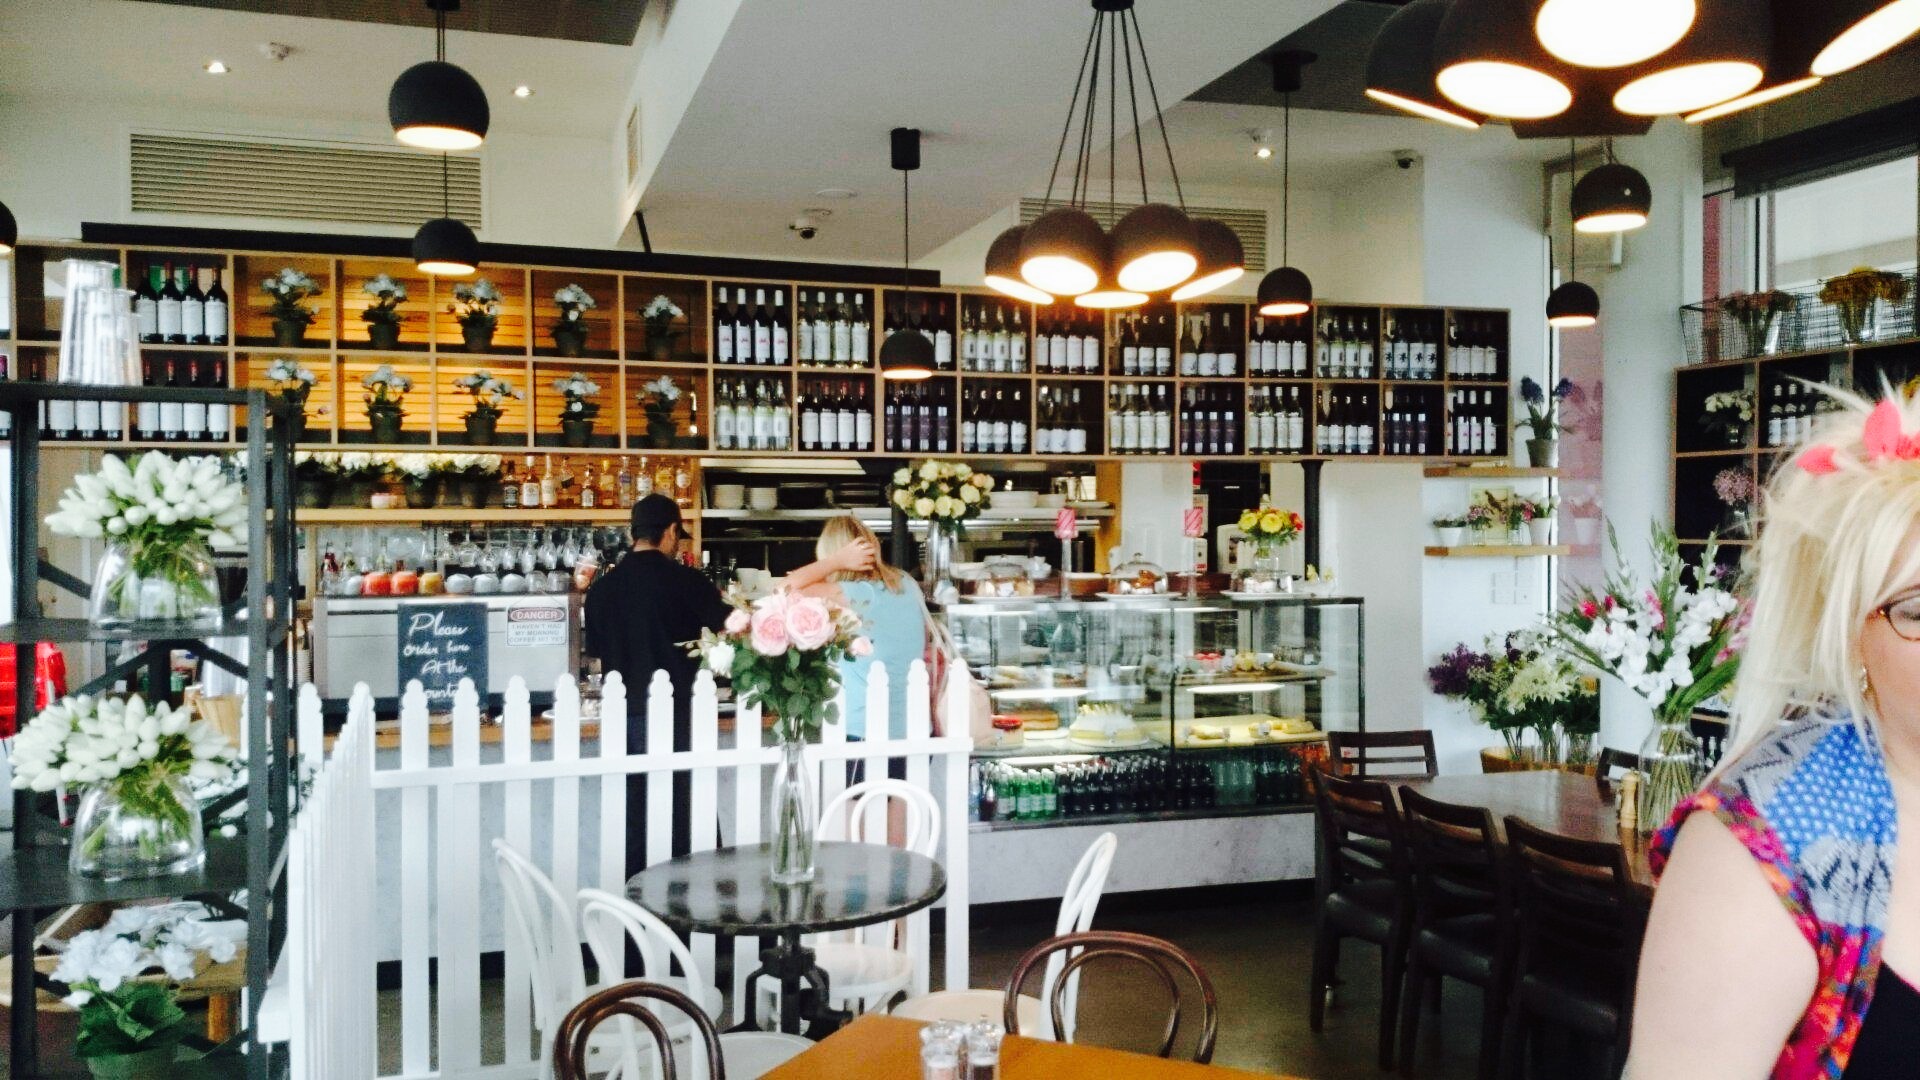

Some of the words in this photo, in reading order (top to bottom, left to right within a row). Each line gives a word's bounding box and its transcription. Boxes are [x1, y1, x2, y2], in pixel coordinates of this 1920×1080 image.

[409, 610, 469, 636] Please
[516, 610, 558, 620] DANGER
[446, 658, 468, 674] the
